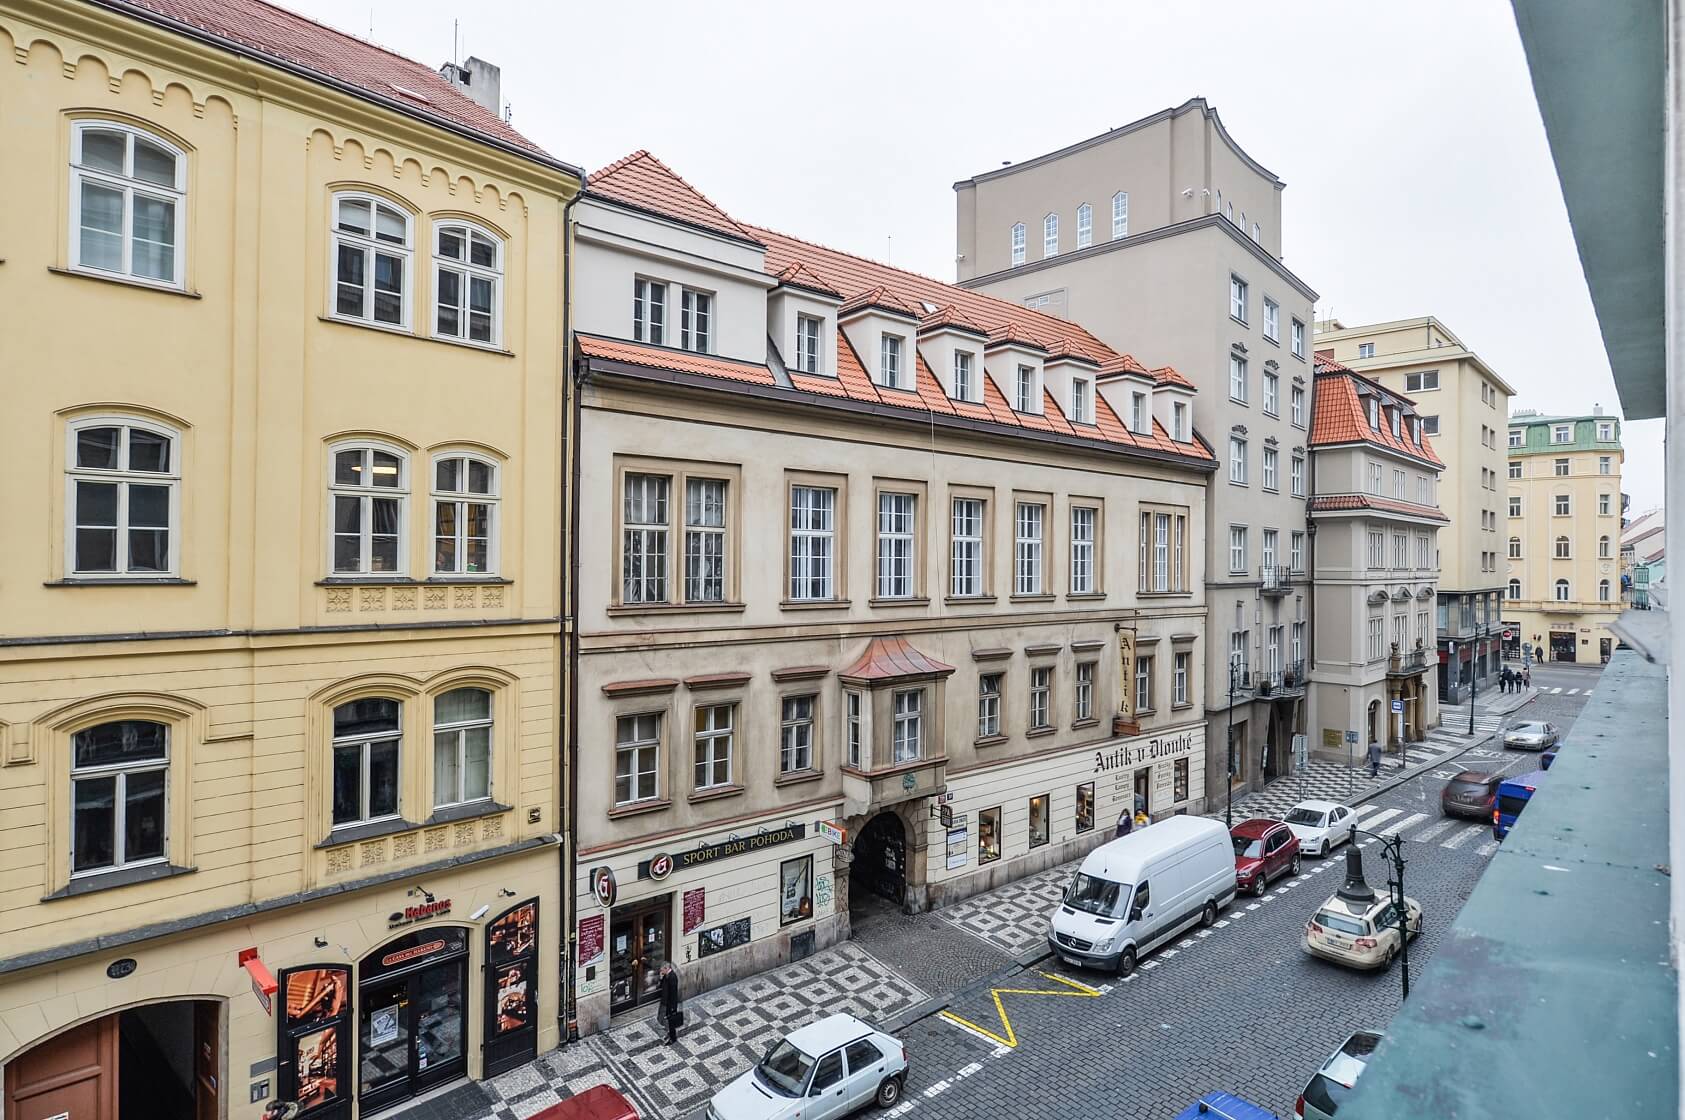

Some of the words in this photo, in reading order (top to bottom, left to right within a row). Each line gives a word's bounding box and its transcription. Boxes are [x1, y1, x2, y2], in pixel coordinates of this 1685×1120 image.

[1120, 638, 1131, 713] Antik
[1094, 747, 1132, 773] Antik
[1149, 732, 1192, 759] Dlouhé
[683, 847, 720, 865] SPORT
[724, 839, 745, 854] BAR
[750, 829, 794, 849] POHODA
[405, 899, 452, 920] Habanos
